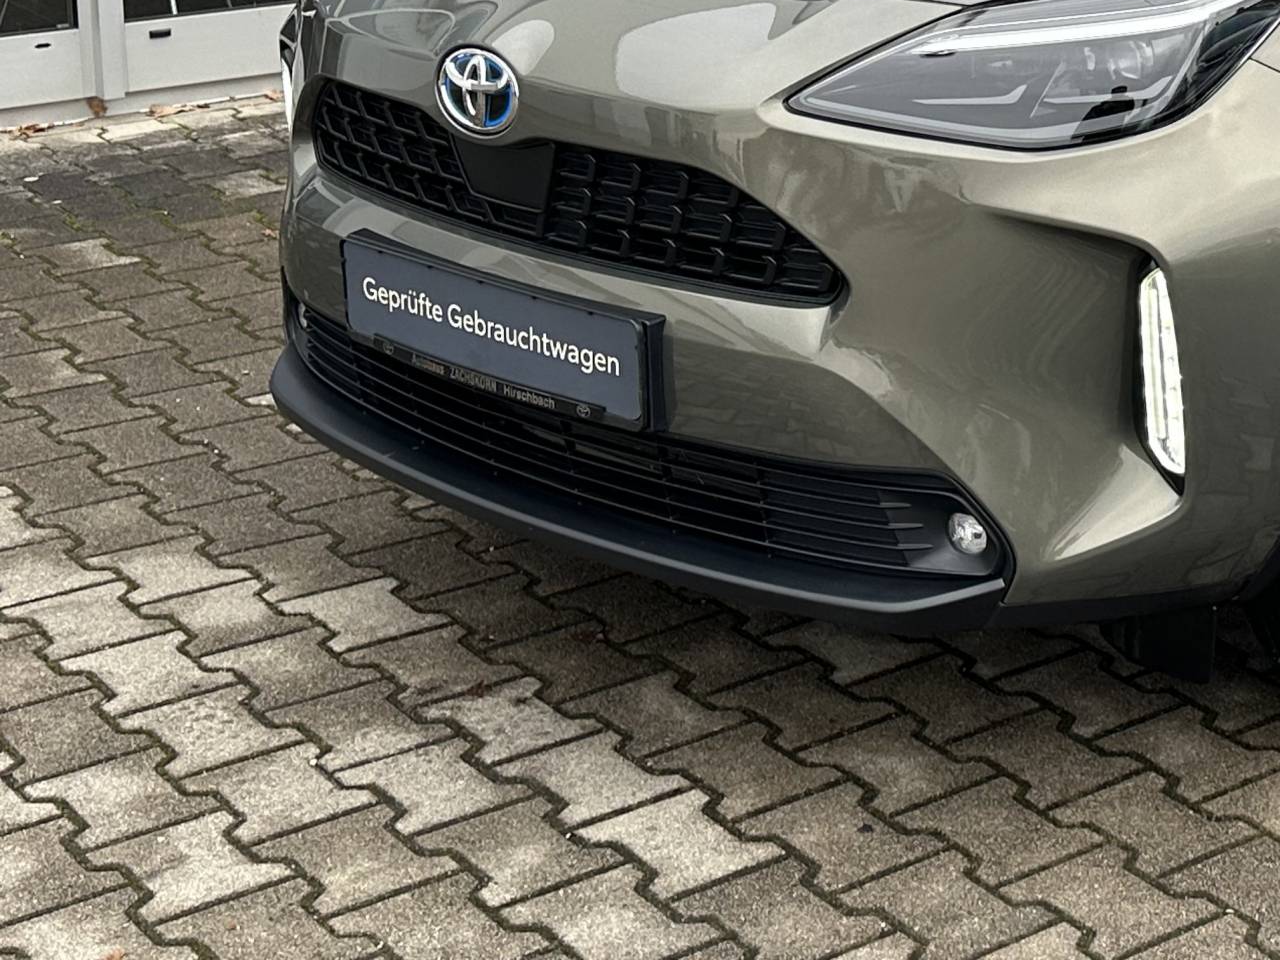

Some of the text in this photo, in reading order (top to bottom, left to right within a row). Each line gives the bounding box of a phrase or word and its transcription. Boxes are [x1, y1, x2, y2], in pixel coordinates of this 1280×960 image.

[362, 276, 621, 377] Geprüfte Gebrauchtwagen
[502, 383, 556, 410] Hirschbach
